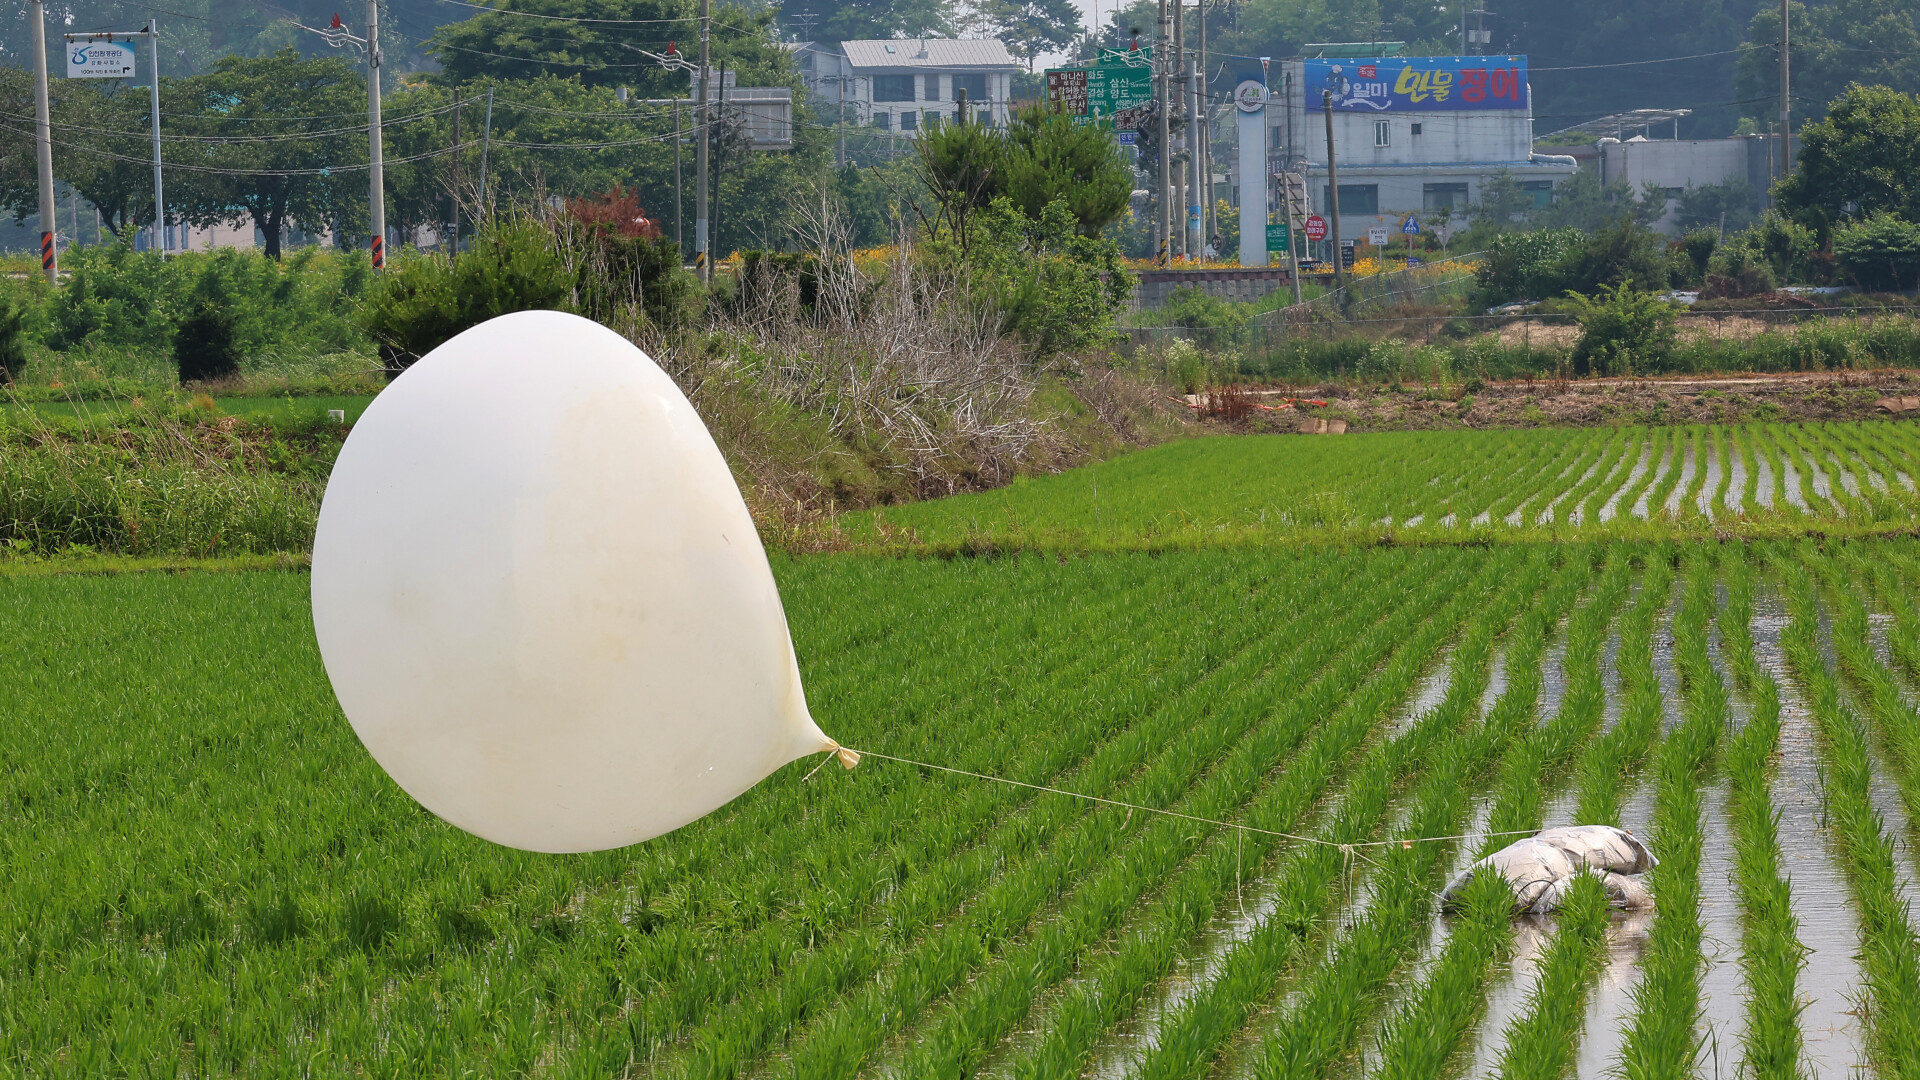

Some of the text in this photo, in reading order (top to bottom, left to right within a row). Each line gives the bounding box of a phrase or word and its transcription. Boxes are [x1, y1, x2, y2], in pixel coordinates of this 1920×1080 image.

[1060, 71, 1084, 81] 마니산
[1087, 70, 1106, 80] 화도
[1109, 78, 1129, 88] 삼산
[1352, 65, 1519, 103] 일미 민물 장어
